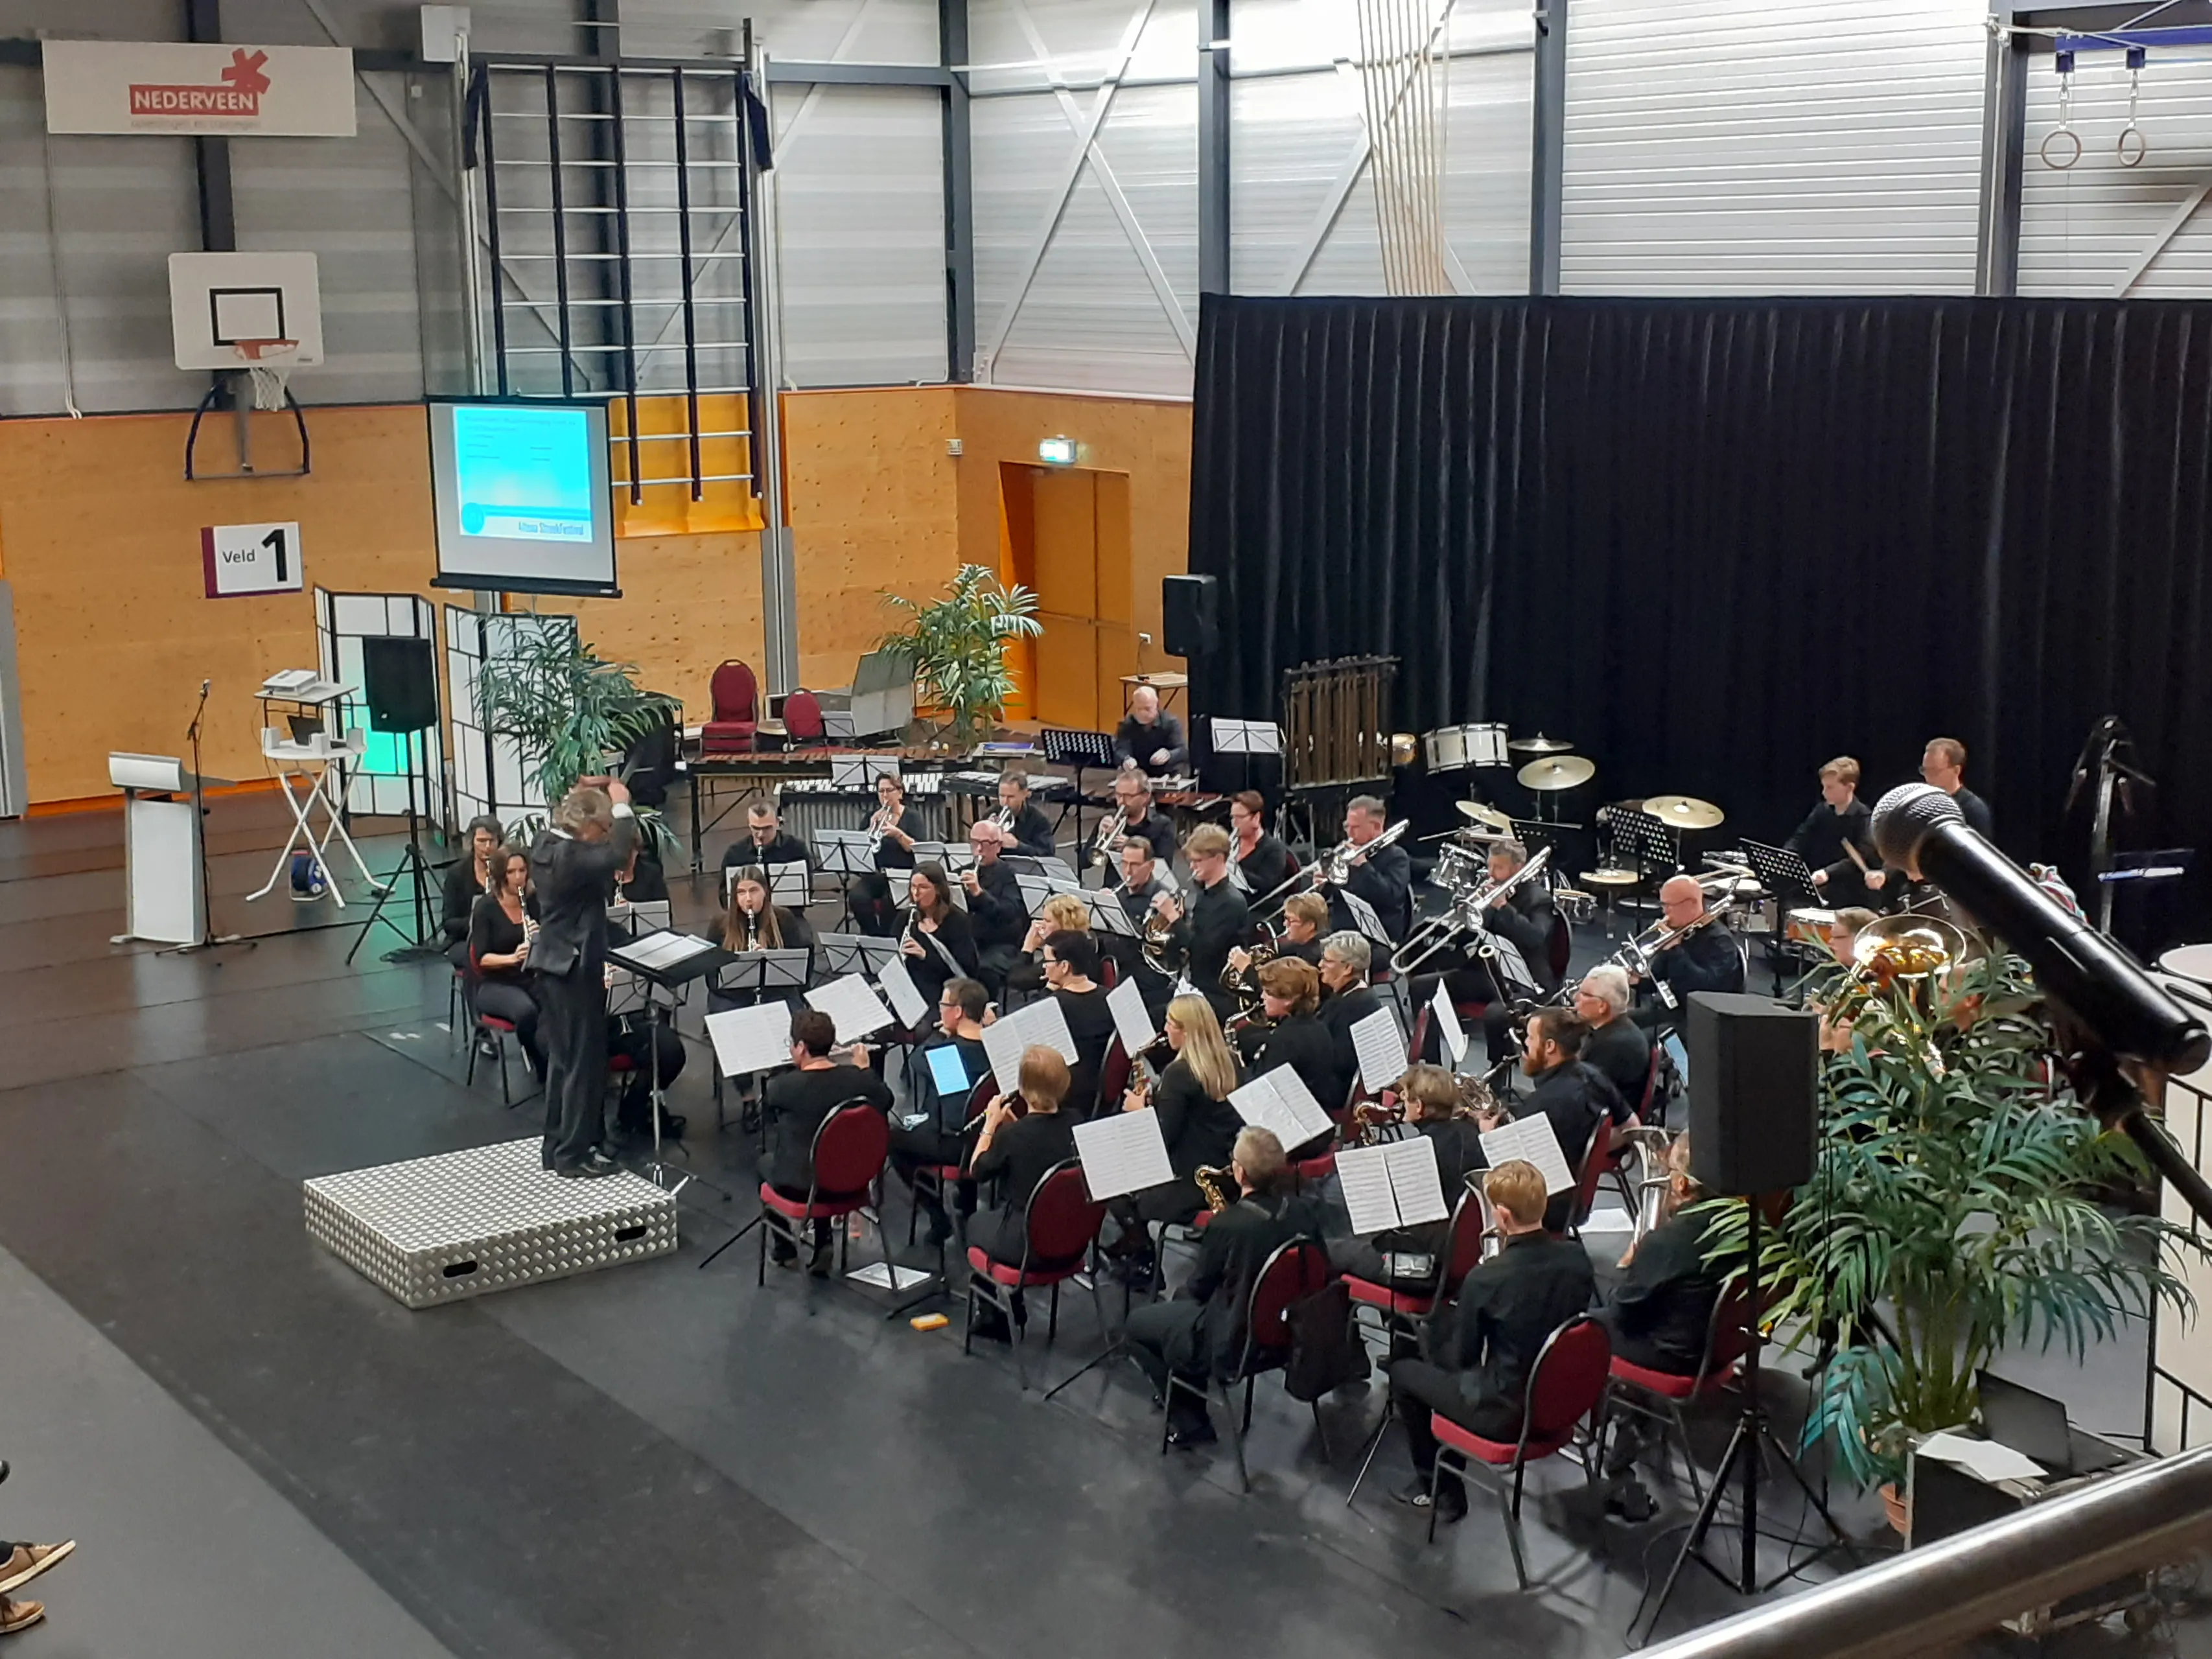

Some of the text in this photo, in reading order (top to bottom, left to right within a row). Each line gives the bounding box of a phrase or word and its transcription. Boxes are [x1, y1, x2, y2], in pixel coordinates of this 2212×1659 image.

[134, 90, 254, 110] NEDERVEEN
[222, 529, 288, 582] Veld 1
